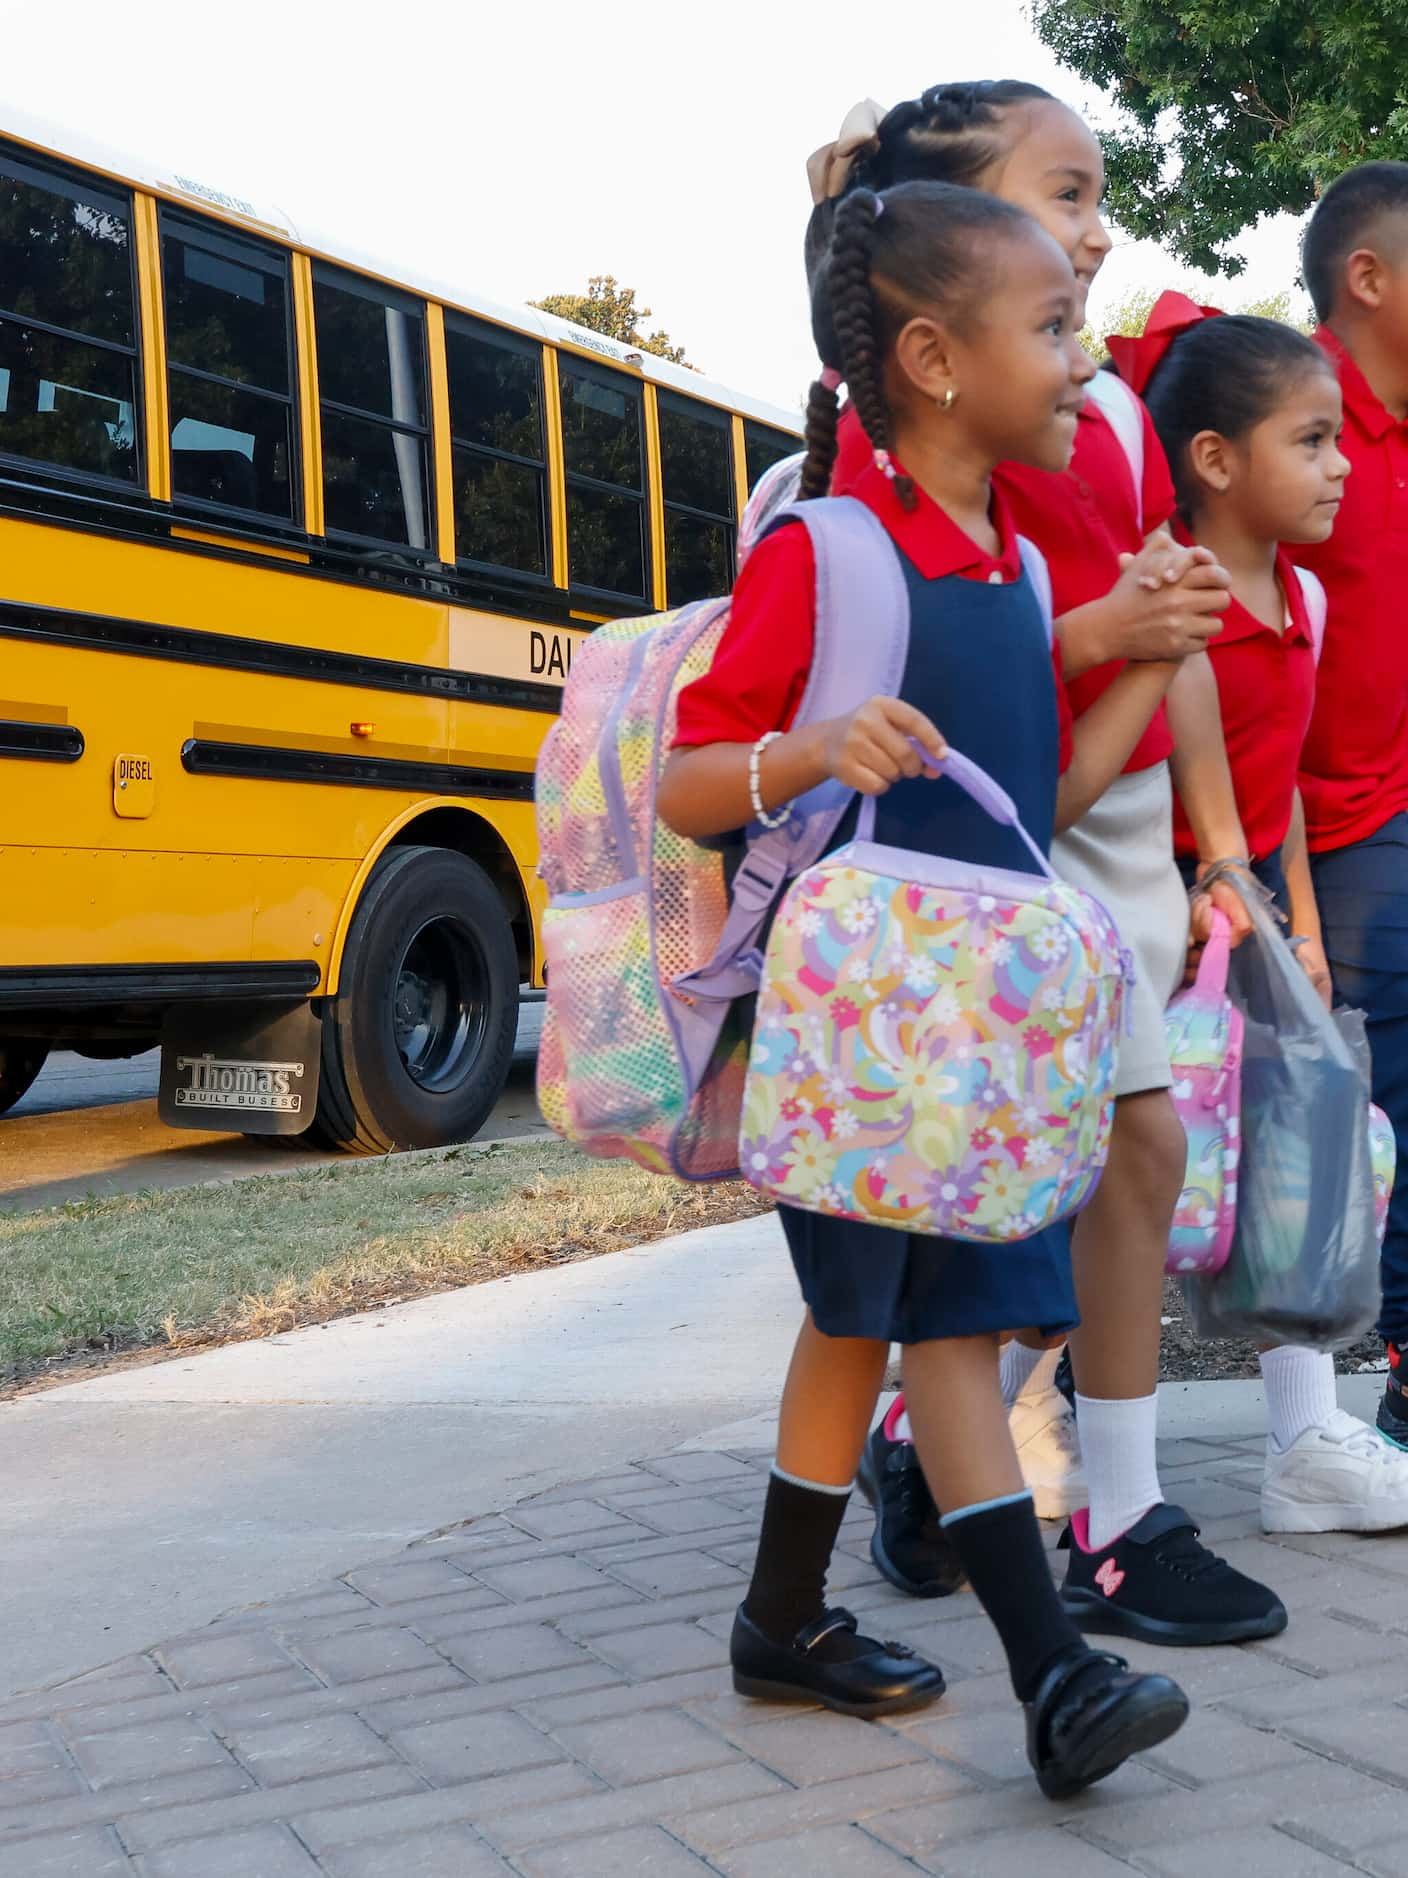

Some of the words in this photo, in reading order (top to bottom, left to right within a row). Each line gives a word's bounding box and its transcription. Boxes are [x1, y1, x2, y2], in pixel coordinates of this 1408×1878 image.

[120, 760, 152, 780] DIESEL
[178, 1053, 303, 1094] Thomas
[189, 1092, 229, 1103] BUILT
[238, 1095, 288, 1106] BUSES
